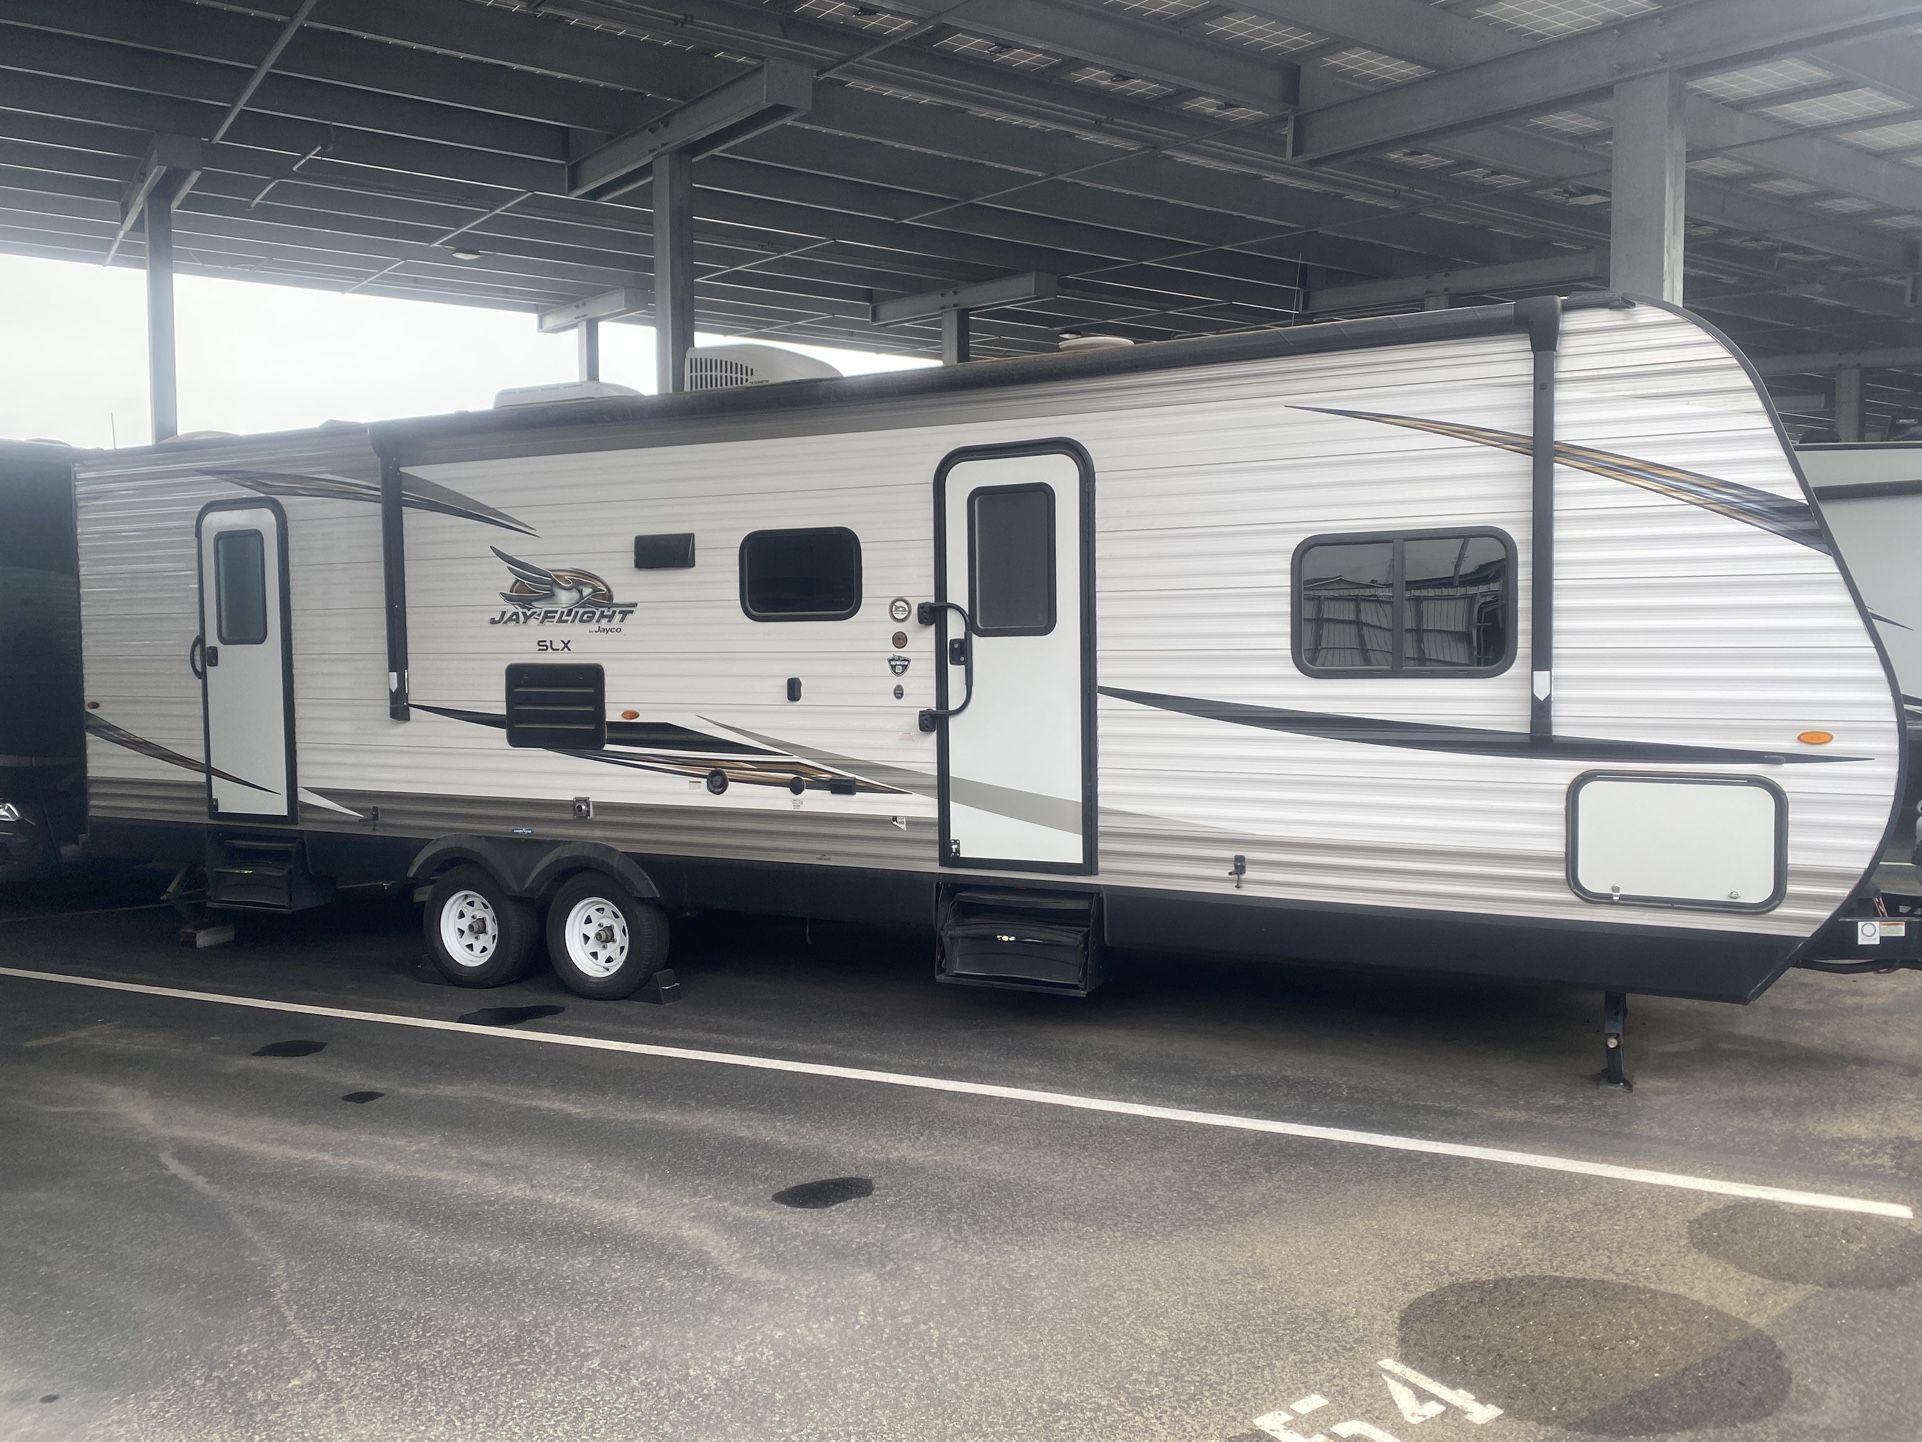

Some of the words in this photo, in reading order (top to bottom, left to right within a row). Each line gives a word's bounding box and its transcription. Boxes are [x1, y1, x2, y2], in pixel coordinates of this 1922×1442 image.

[490, 610, 538, 625] JAY
[539, 609, 635, 624] FLIGHT
[594, 625, 622, 635] Jayco
[537, 639, 572, 652] SLX
